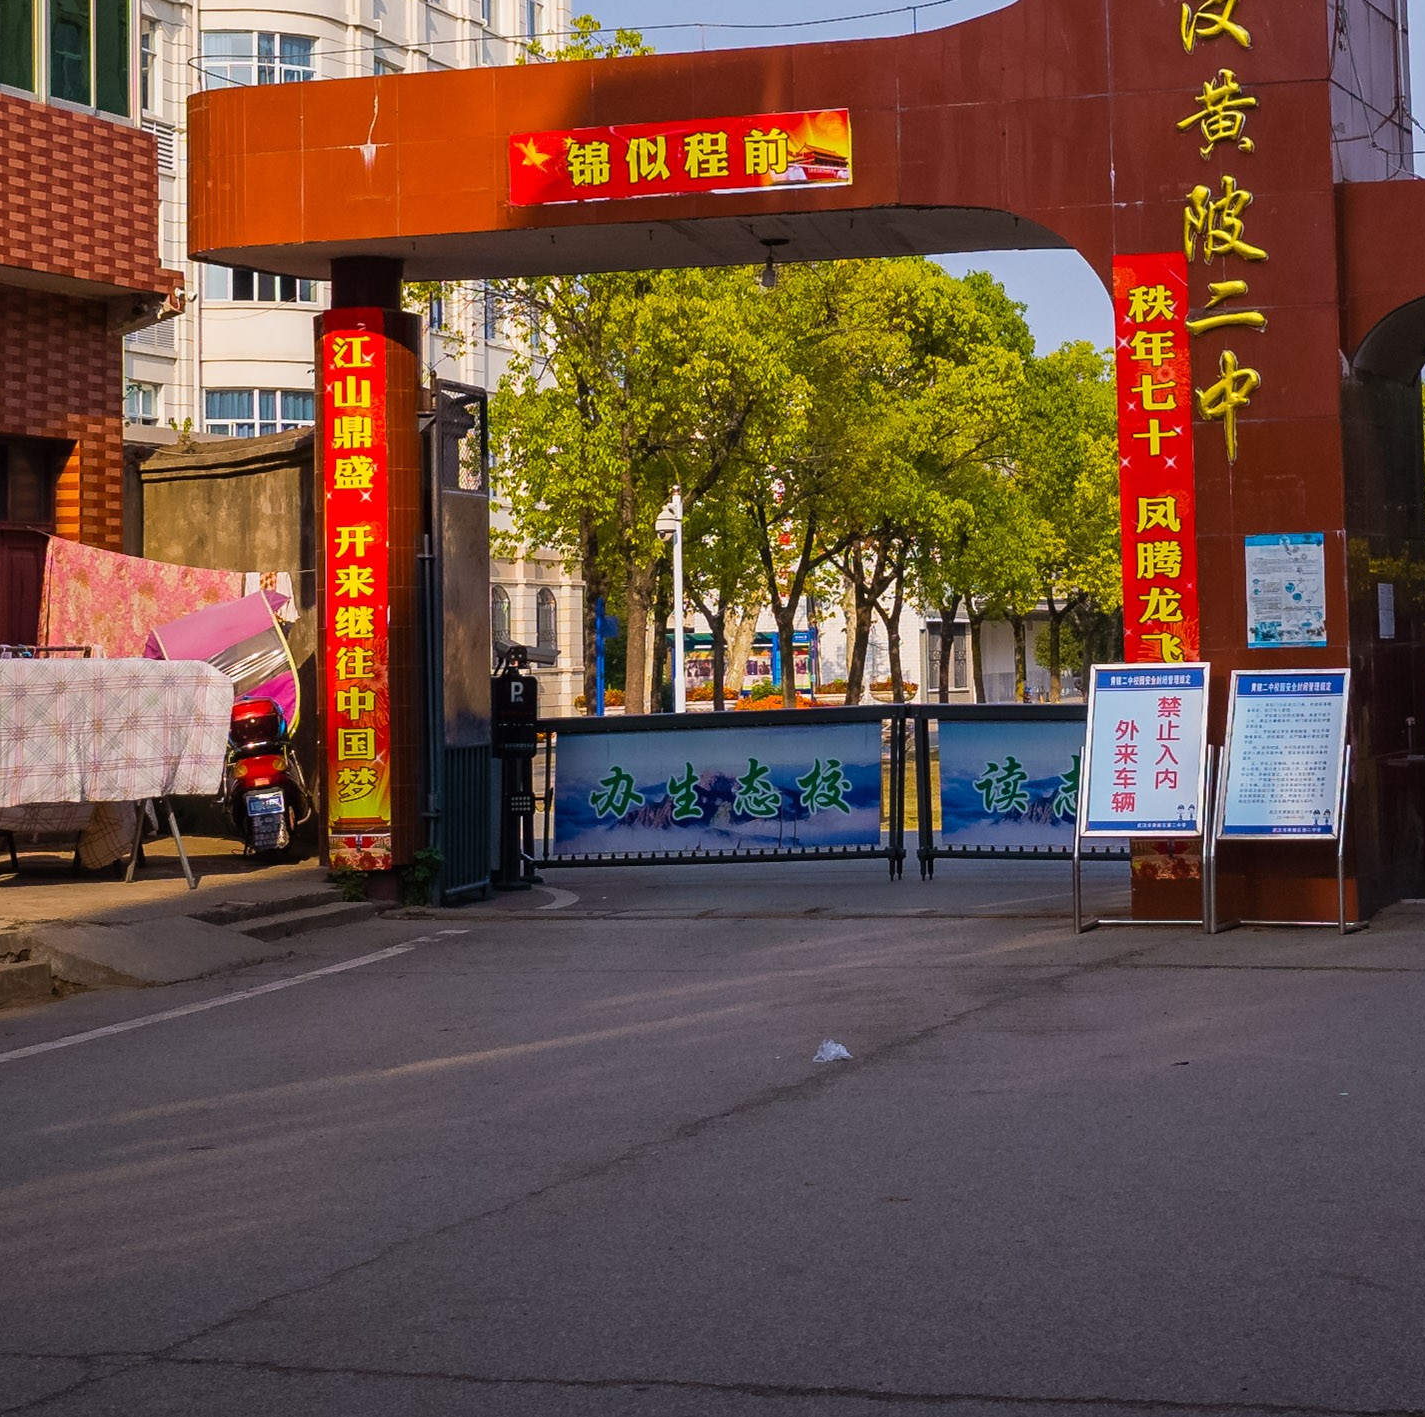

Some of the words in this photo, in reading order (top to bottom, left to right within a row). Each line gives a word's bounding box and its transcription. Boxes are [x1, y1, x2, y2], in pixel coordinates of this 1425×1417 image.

[331, 335, 375, 490] 江山鼎盛
[1128, 285, 1178, 456] 秩年七十
[1135, 496, 1184, 662] 凤腾龙飞
[333, 524, 377, 803] 开来继往中国梦
[590, 756, 853, 820] 办生态校
[1111, 719, 1138, 813] 外来车辆
[1154, 696, 1182, 790] 禁止入内
